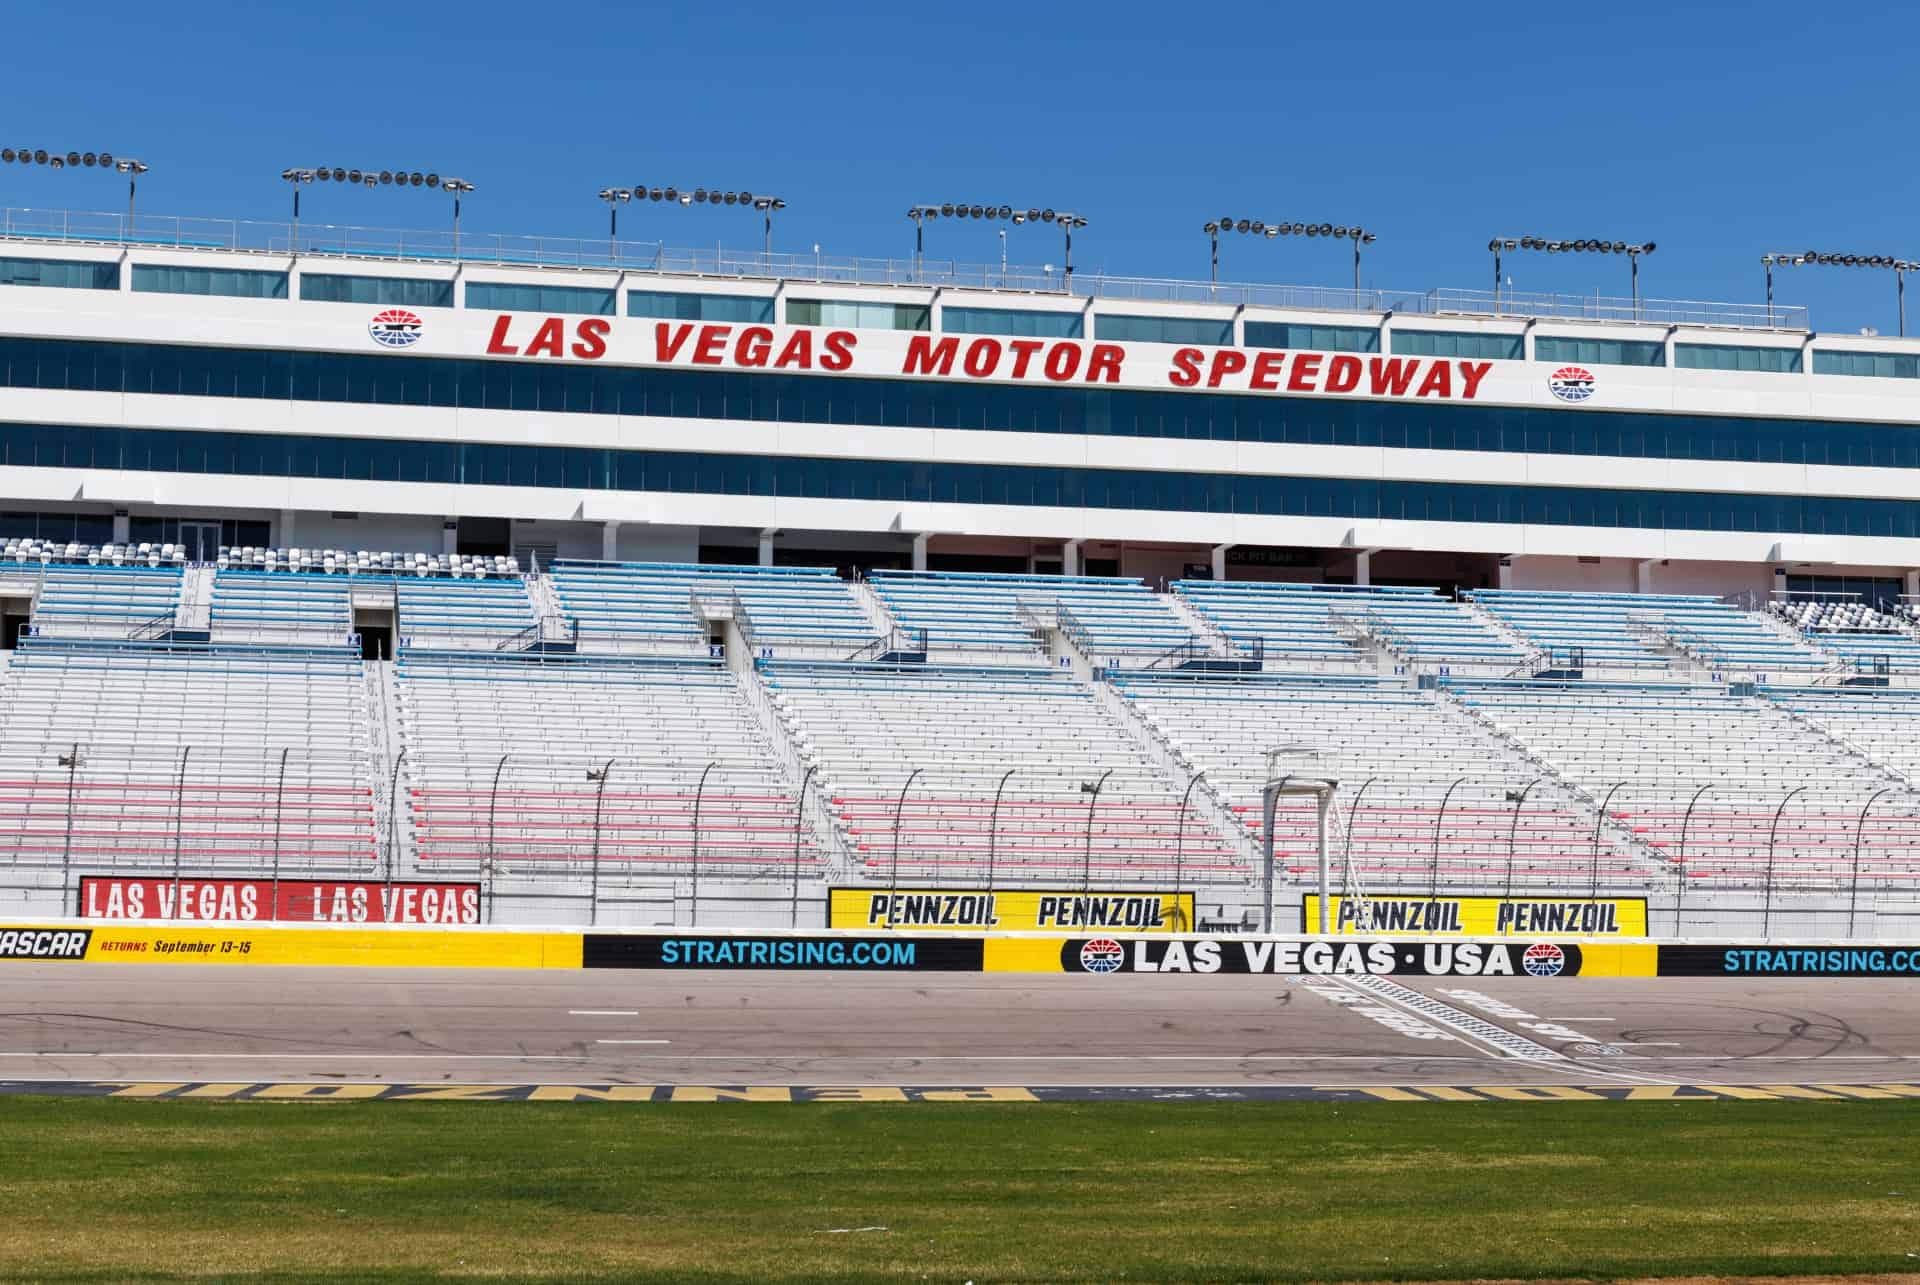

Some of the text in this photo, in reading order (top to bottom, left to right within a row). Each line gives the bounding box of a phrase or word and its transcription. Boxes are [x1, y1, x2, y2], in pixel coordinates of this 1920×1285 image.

[487, 315, 1493, 399] LAS VEGAS MOTOR SPEEDWAY
[87, 883, 479, 924] LAS VEGAS LAS VEGAS
[868, 894, 1164, 927] PENNZOIL PENNZOIL
[1496, 902, 1620, 934] PENNZOIL
[0, 931, 86, 956] ASCAR
[101, 941, 148, 952] RETURNS
[154, 940, 216, 954] September
[661, 940, 915, 965] STRATRISING.COM
[1133, 940, 1515, 976] LAS VEGAS USA
